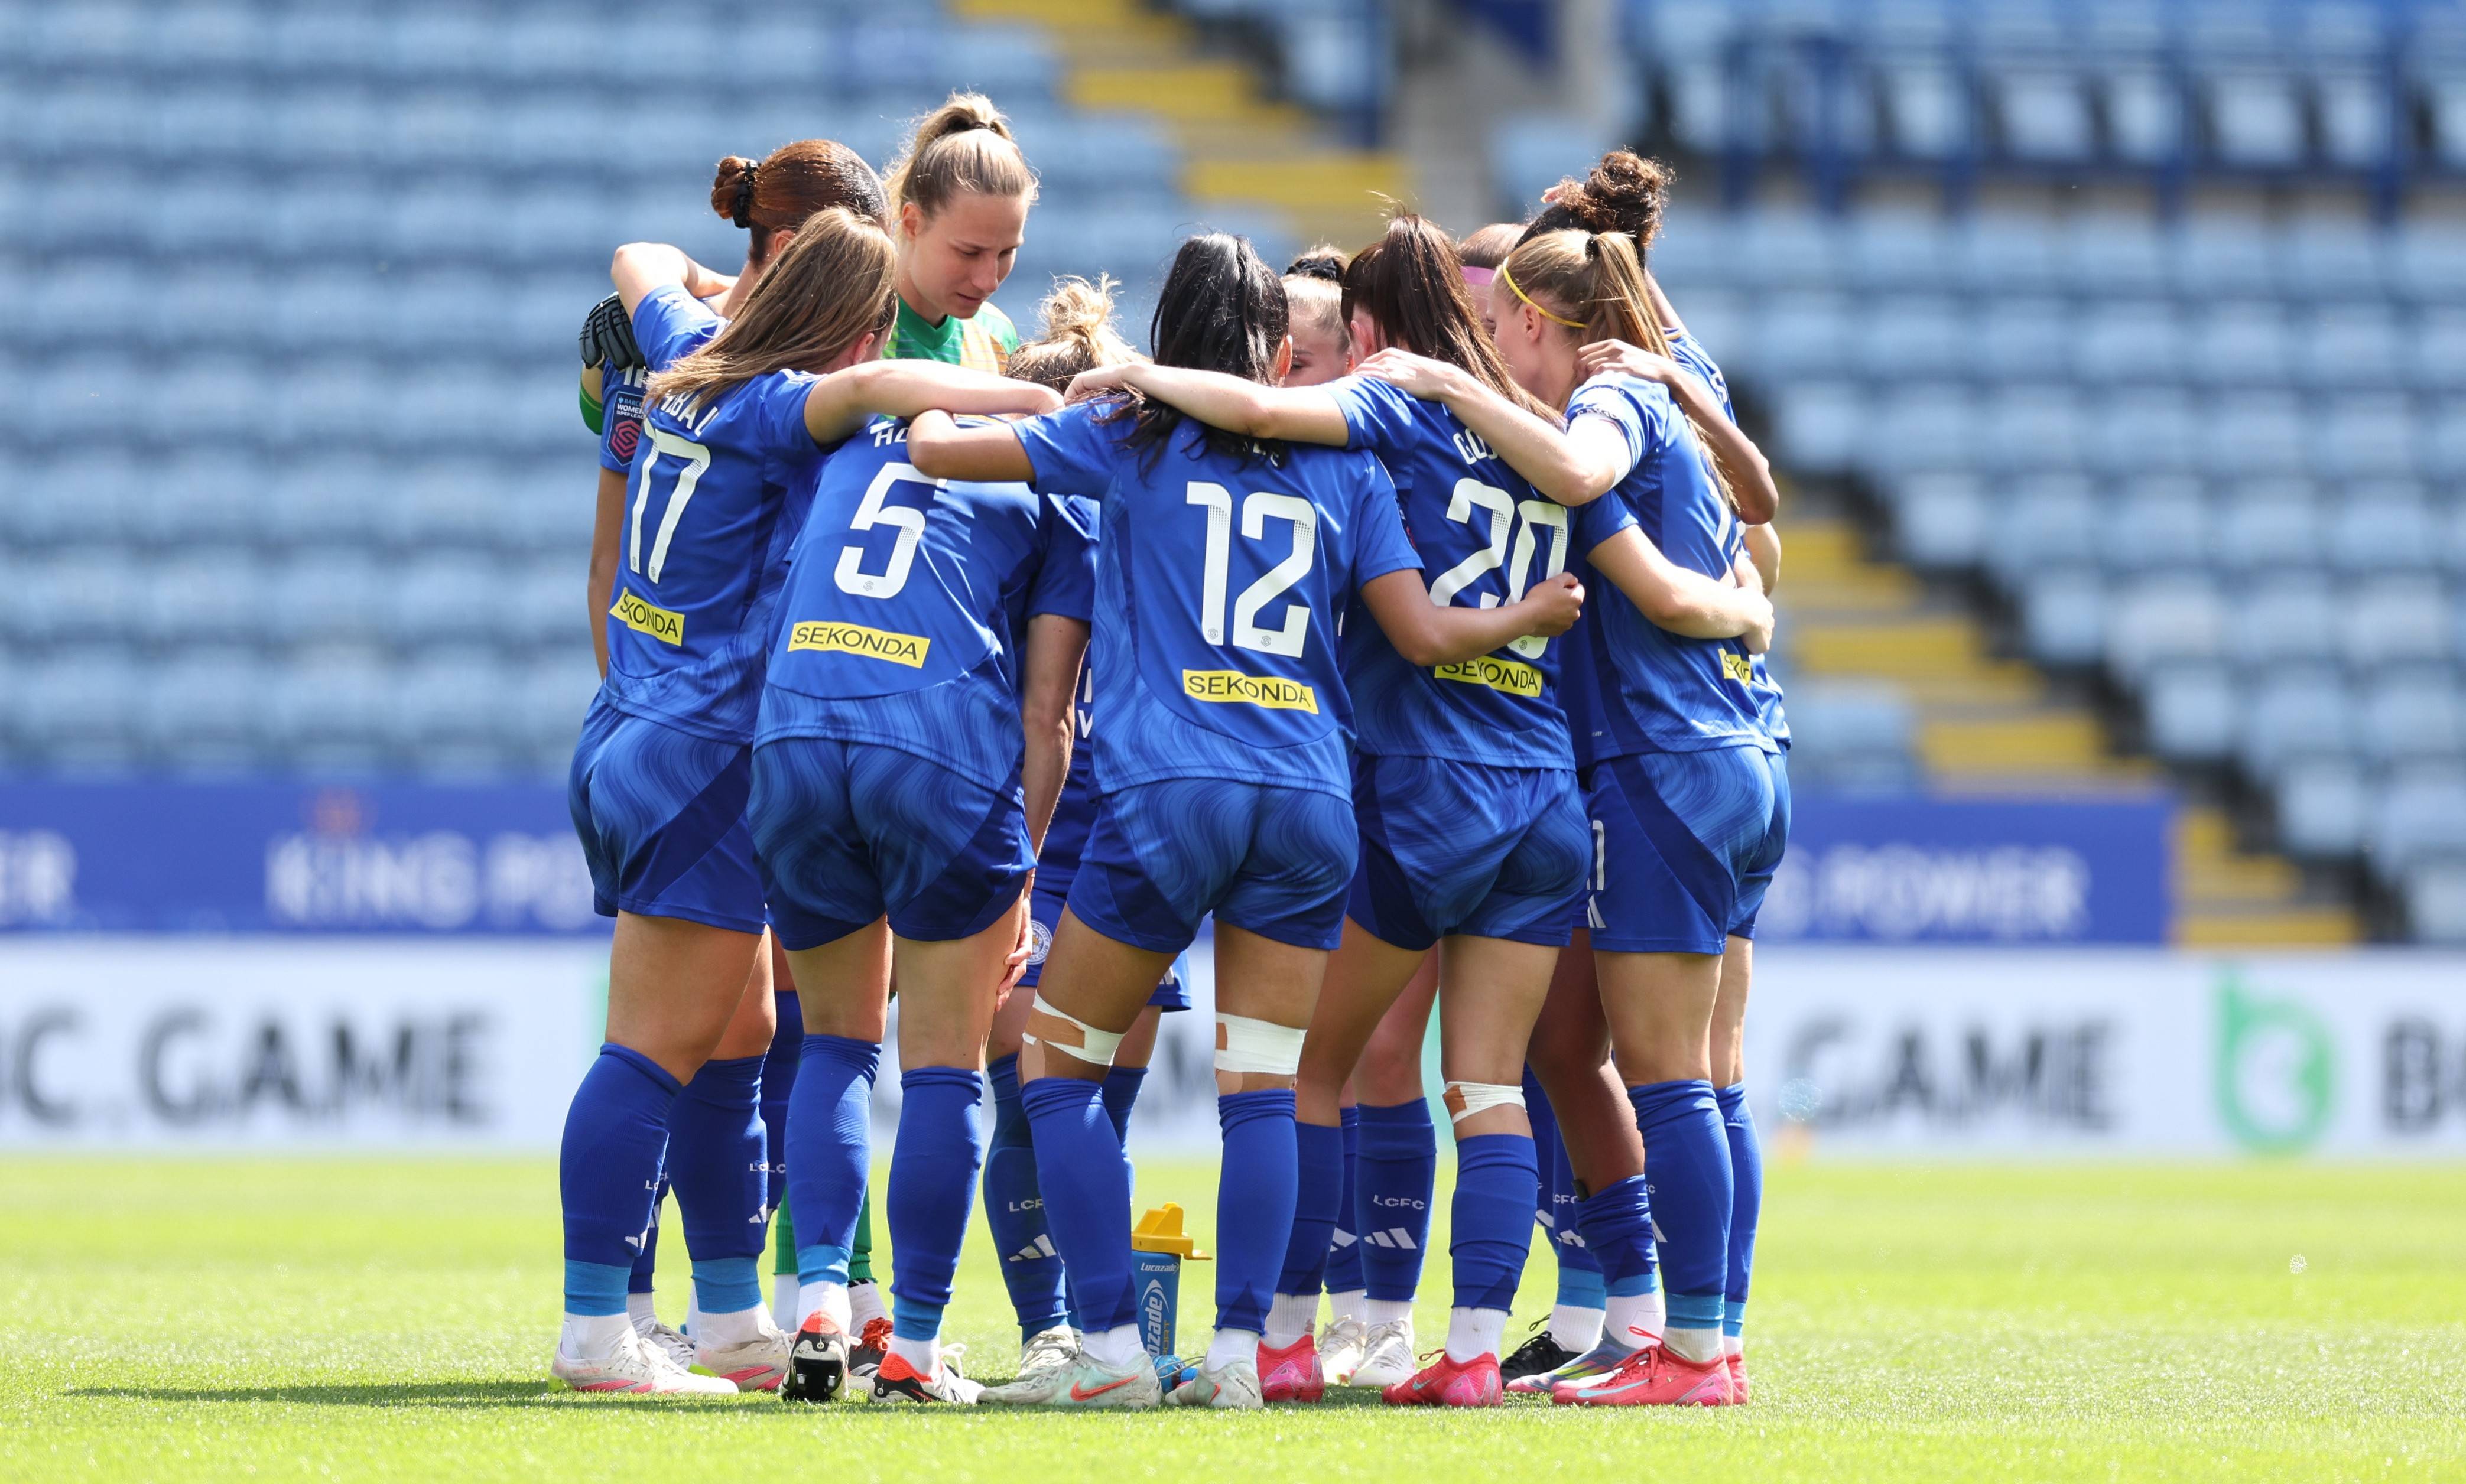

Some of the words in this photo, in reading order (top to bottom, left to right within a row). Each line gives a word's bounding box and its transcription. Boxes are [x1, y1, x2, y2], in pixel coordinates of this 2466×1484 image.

[629, 415, 711, 584] 17
[834, 461, 947, 599] 5
[1187, 481, 1317, 658] 12
[1429, 477, 1568, 659] 20
[620, 594, 678, 638] SKONDA
[794, 627, 917, 660] SEKONDA
[1188, 676, 1311, 708] SEKONDA
[1825, 845, 2088, 935] POWER
[1785, 1009, 2123, 1131] GAME
[1009, 1199, 1044, 1212] LCF
[1373, 1195, 1424, 1210] LCFC
[1141, 1262, 1177, 1272] Lucozade
